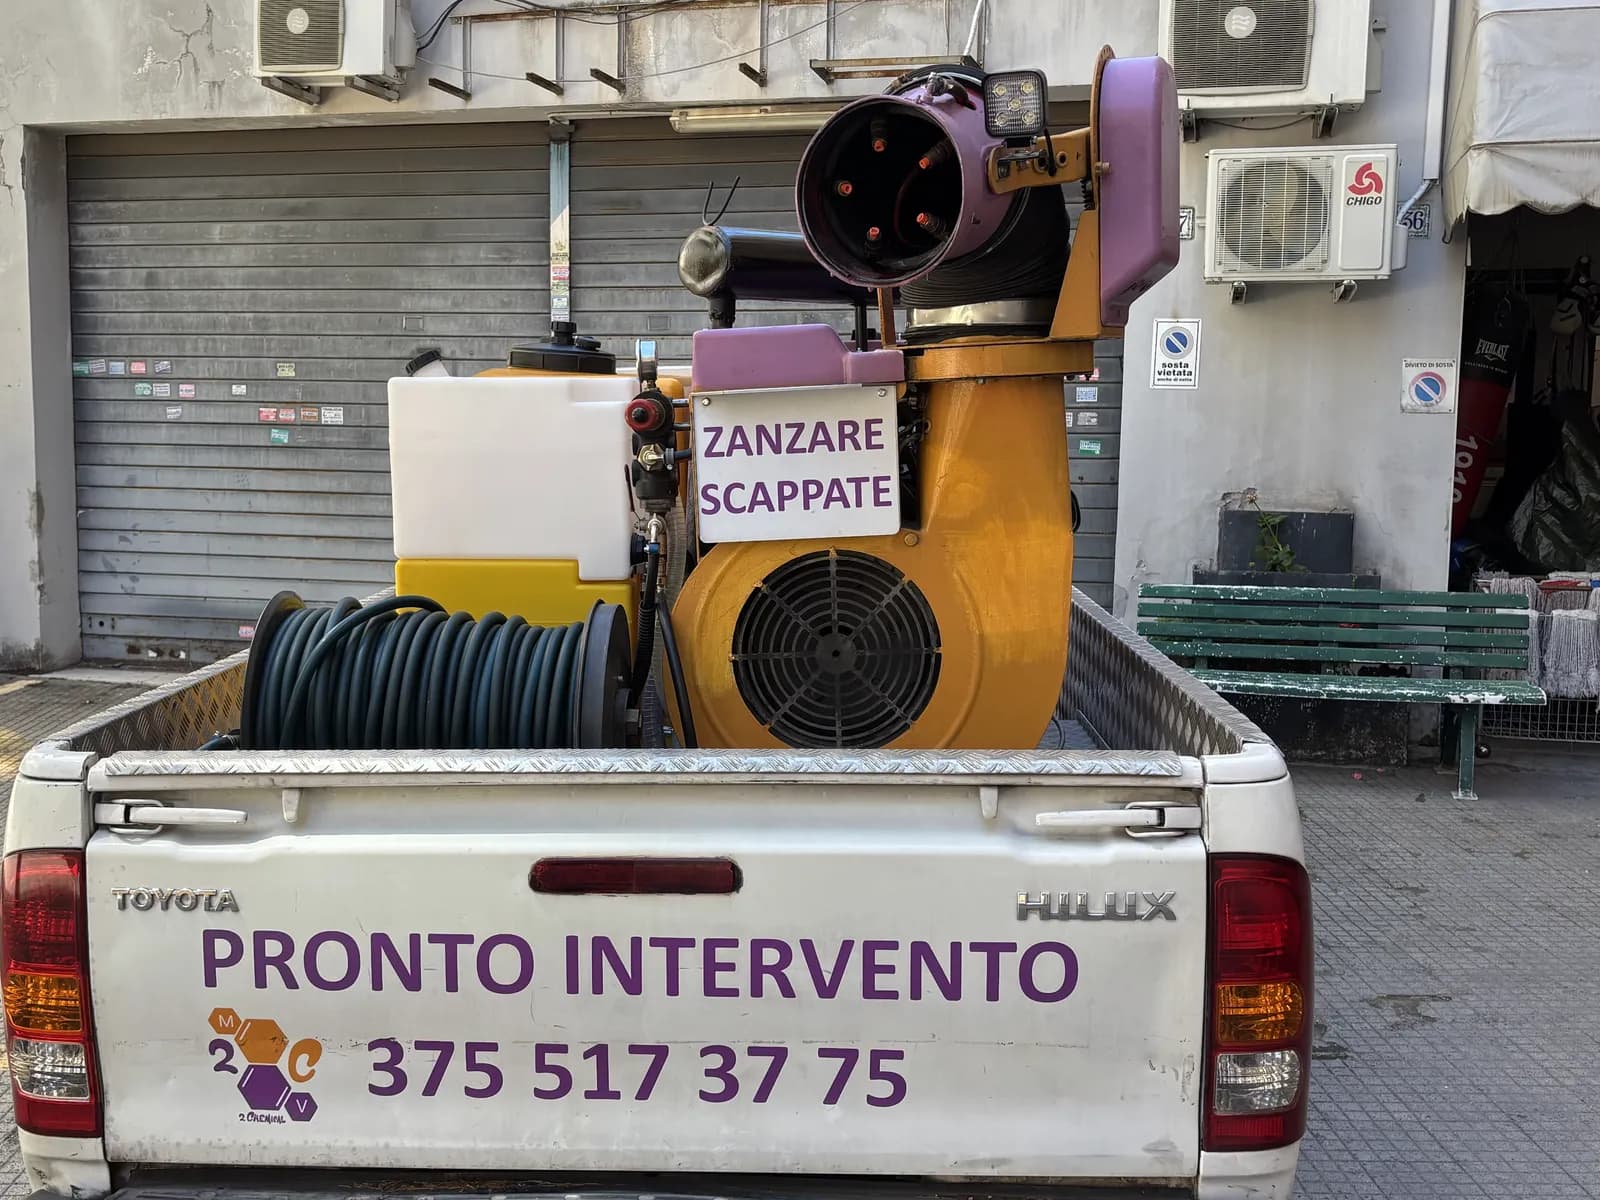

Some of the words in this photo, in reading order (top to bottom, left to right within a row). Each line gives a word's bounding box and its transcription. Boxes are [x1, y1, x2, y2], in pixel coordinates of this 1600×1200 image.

[1346, 196, 1382, 206] CHIGO
[1475, 338, 1510, 362] EVERLAST
[1161, 361, 1189, 369] sosta
[703, 418, 885, 458] ZANZARE
[701, 475, 893, 516] SCAPPATE
[111, 887, 240, 912] TOYOTA
[1016, 891, 1177, 921] HILUX
[204, 930, 534, 994] PRONTO
[565, 936, 1078, 1003] INTERVENTO
[218, 1014, 234, 1028] M
[208, 1038, 238, 1074] 2
[369, 1039, 503, 1098] 375
[535, 1043, 668, 1100] 517
[700, 1045, 788, 1102] 37
[818, 1047, 906, 1106] 75
[238, 1113, 246, 1121] 2
[296, 1099, 308, 1113] V
